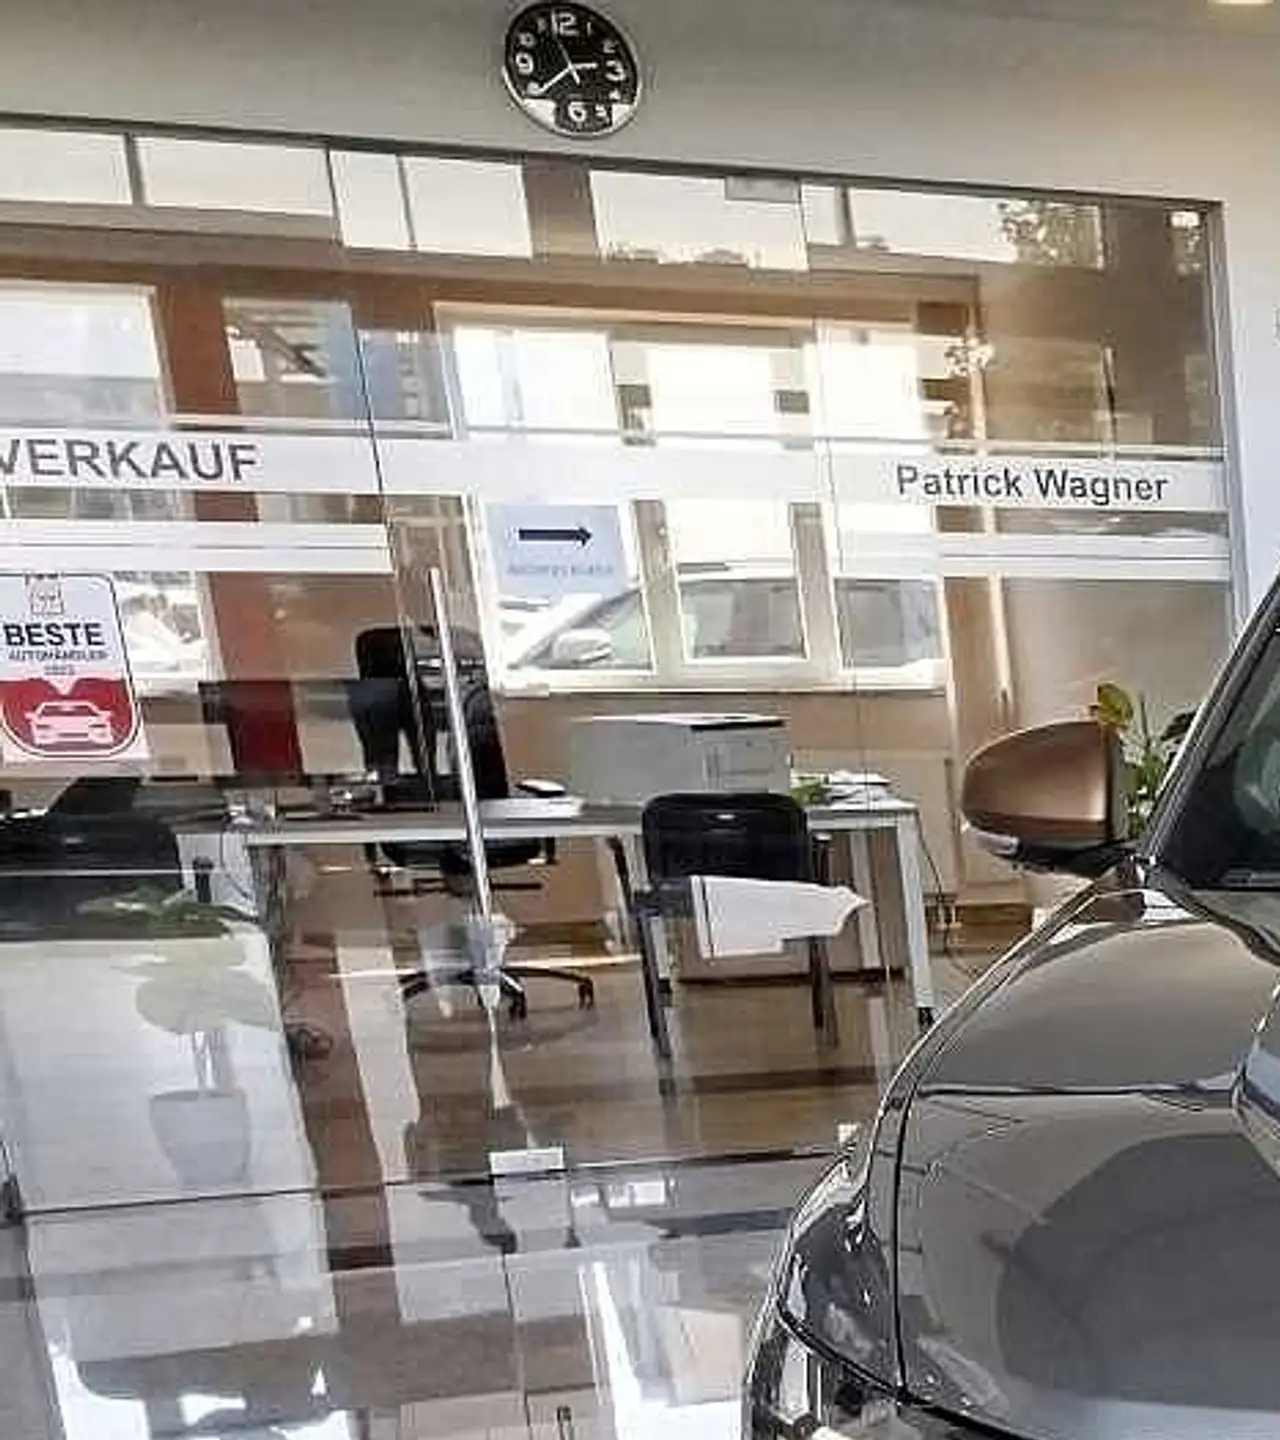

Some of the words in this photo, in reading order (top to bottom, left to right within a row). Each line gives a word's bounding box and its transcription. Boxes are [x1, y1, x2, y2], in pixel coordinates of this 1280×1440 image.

[551, 10, 579, 36] 12
[515, 52, 534, 75] 9
[605, 60, 626, 81] 3
[567, 101, 587, 122] 6
[896, 464, 1024, 498] Patrick
[1034, 468, 1170, 506] Wagner
[3, 622, 106, 647] BESTE
